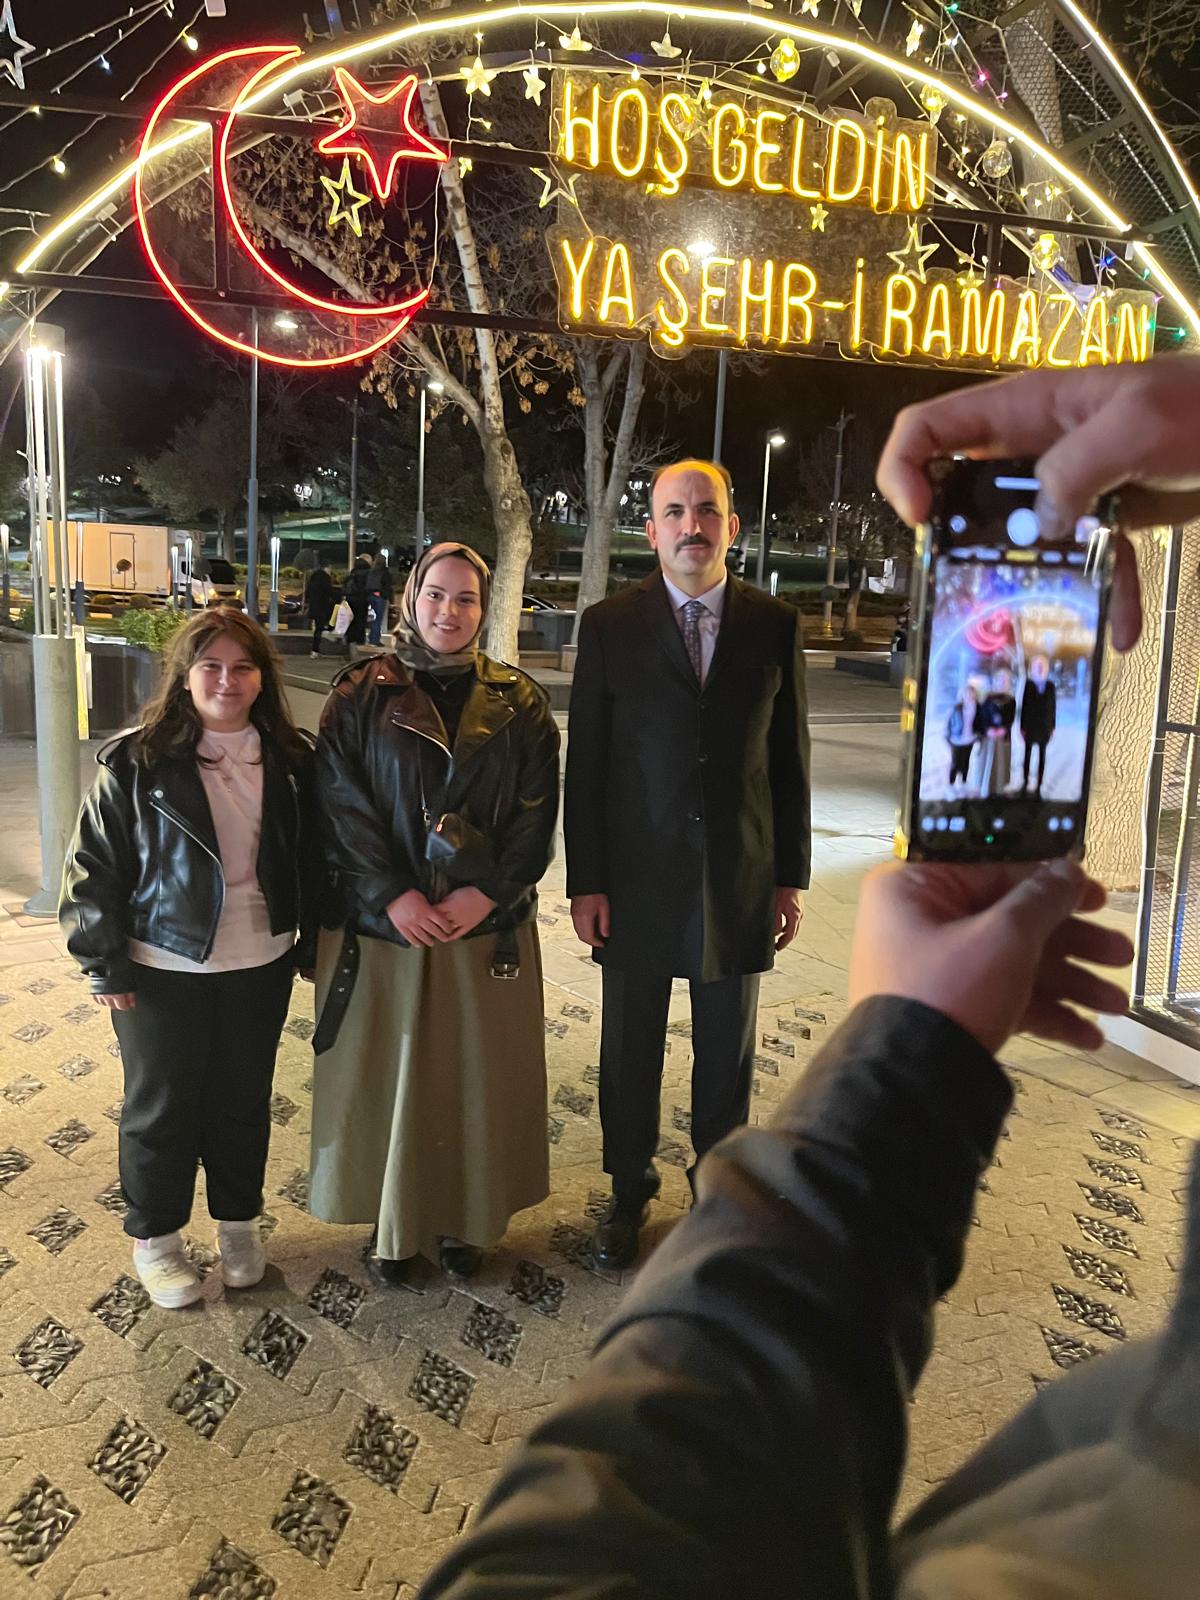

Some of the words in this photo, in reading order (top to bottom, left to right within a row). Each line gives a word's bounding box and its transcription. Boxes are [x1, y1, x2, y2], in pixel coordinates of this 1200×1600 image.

[563, 80, 690, 195] HOŞ
[712, 102, 928, 211] GELDİN
[561, 239, 635, 328] YA
[882, 273, 1149, 369] RAMAZAN
